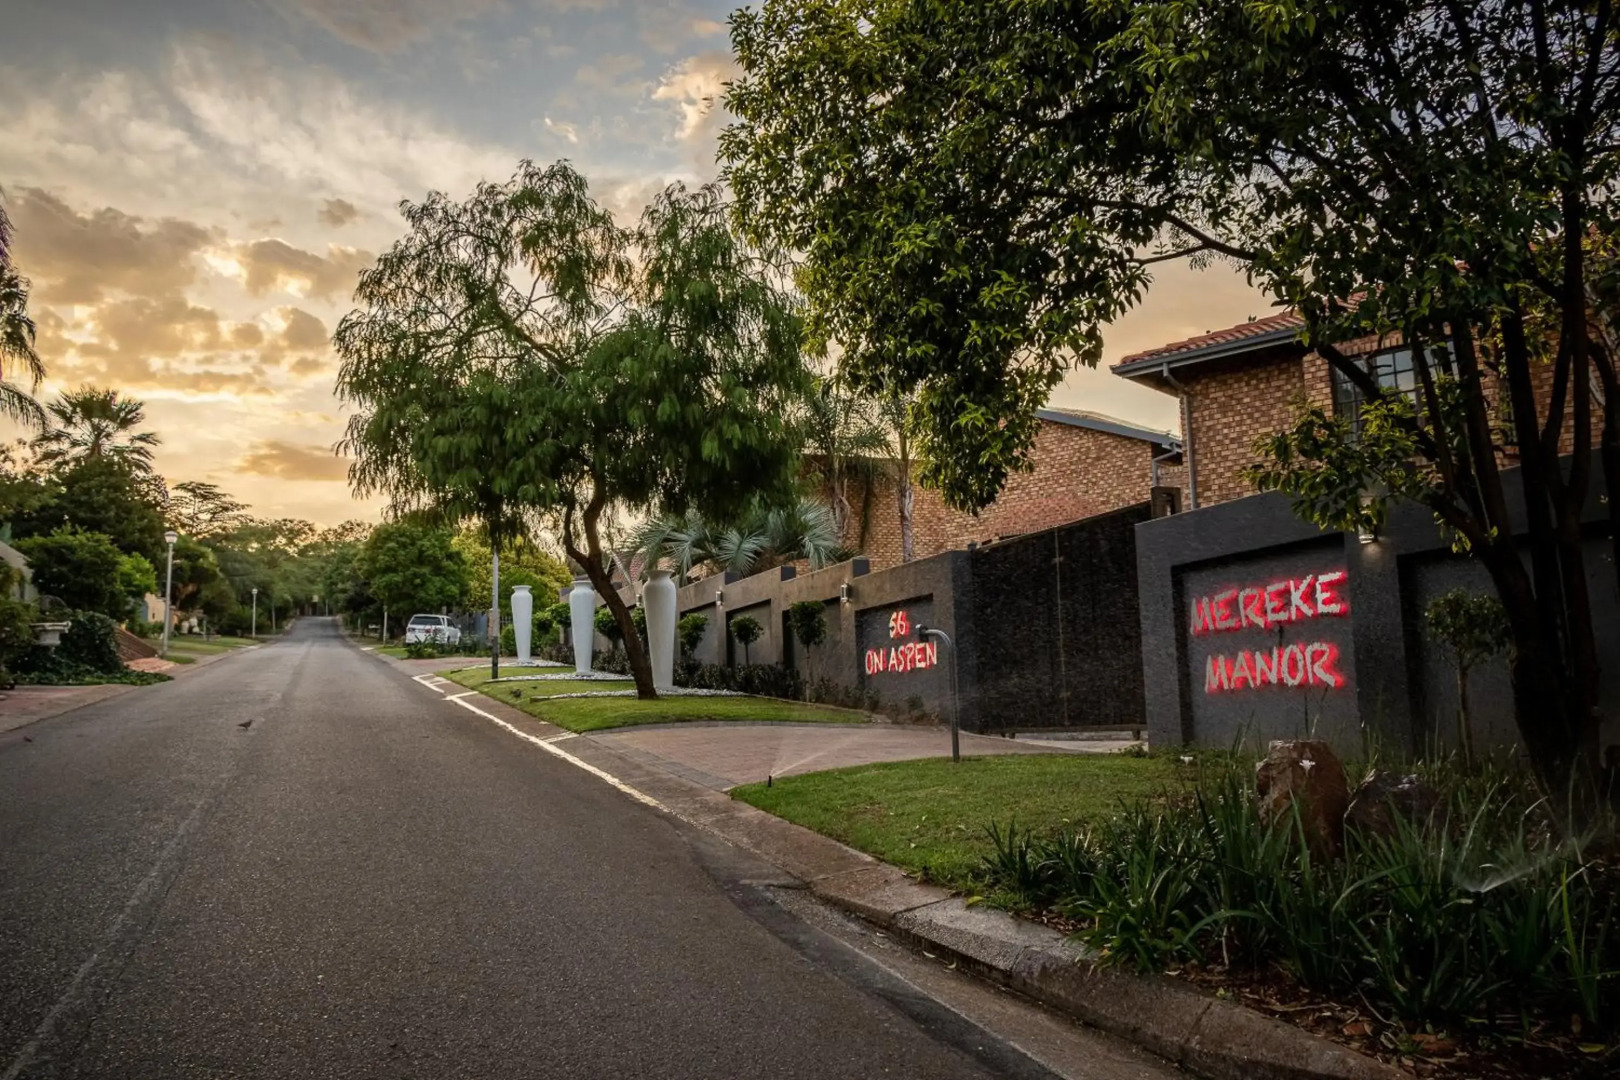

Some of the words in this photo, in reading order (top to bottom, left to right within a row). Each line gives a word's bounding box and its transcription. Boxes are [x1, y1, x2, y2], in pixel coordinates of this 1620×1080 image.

[888, 610, 908, 638] 56
[1189, 571, 1345, 635] MEREKE
[865, 647, 885, 675] ON
[888, 640, 937, 673] ASPEN
[1204, 642, 1337, 693] MANOR
